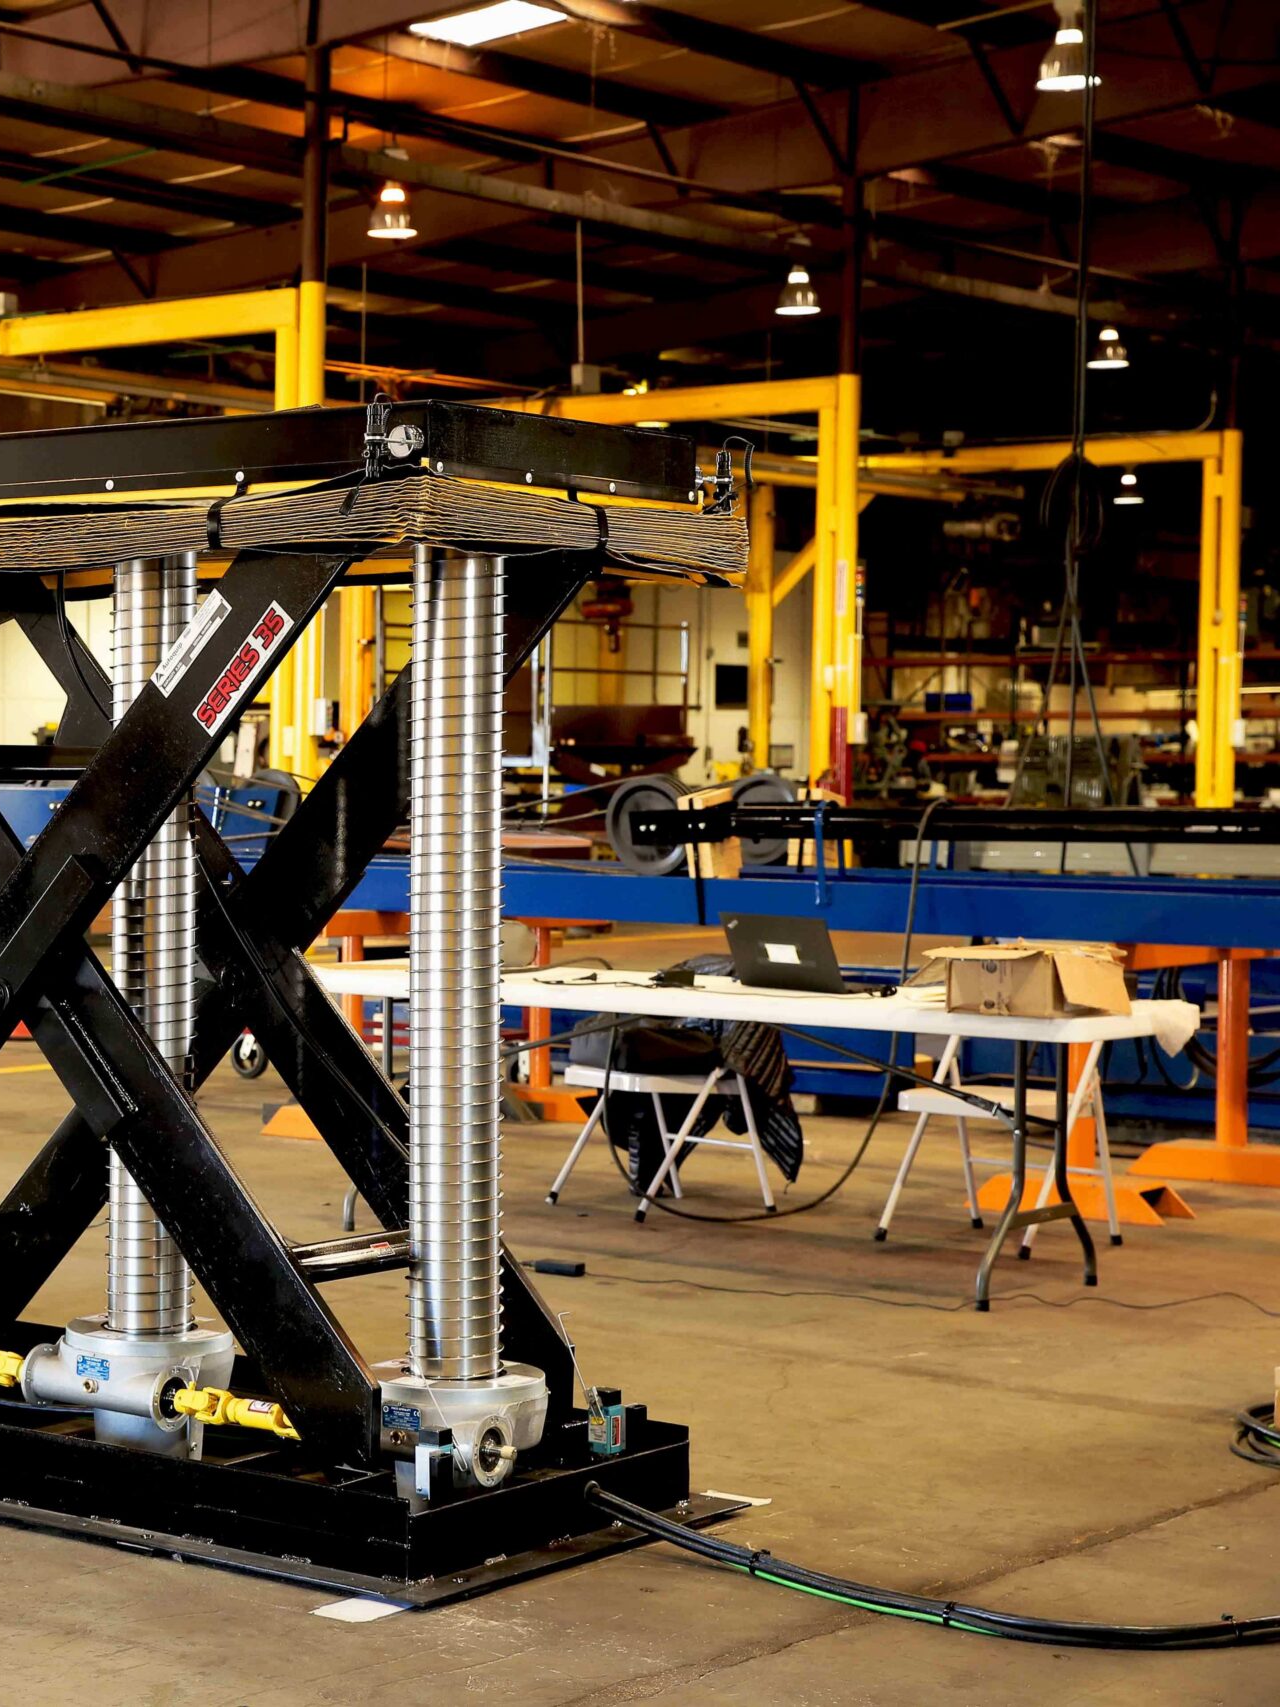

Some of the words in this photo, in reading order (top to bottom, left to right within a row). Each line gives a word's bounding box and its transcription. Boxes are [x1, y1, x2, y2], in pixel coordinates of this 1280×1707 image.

[161, 642, 183, 670] Autoquip
[197, 641, 260, 729] SERIES
[252, 607, 285, 650] 35
